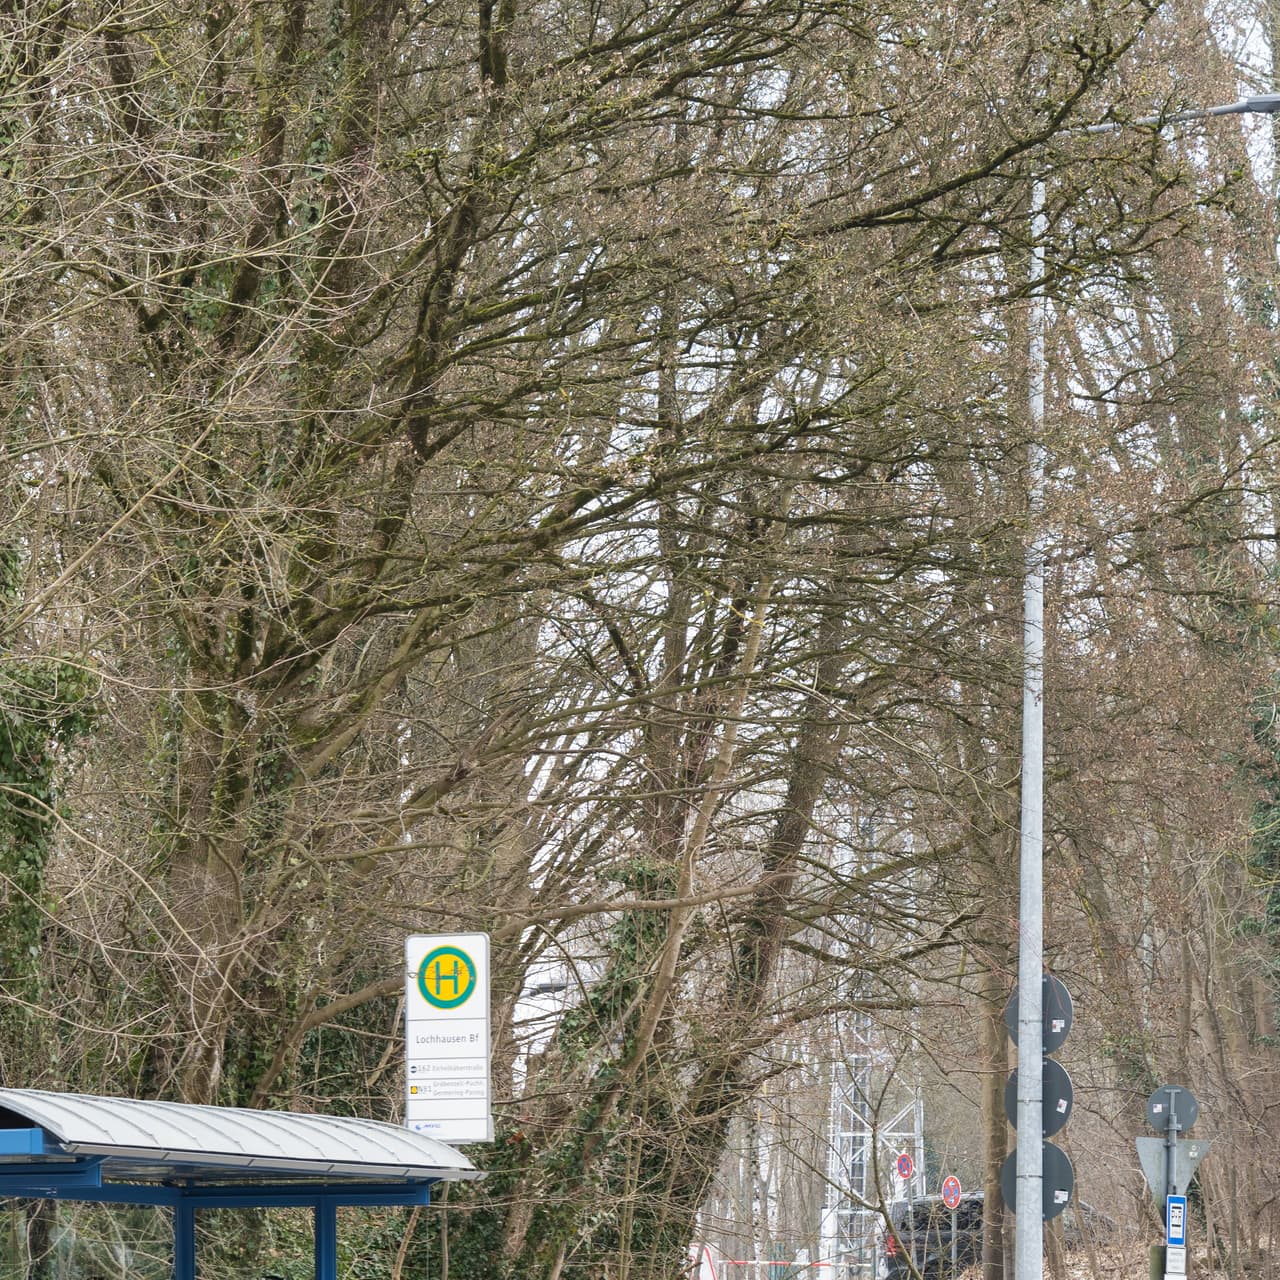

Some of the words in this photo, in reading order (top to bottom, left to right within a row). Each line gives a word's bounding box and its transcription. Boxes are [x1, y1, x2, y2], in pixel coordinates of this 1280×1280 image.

[435, 960, 459, 995] H
[416, 1034, 467, 1044] Lochhausen
[469, 1033, 479, 1042] Bf
